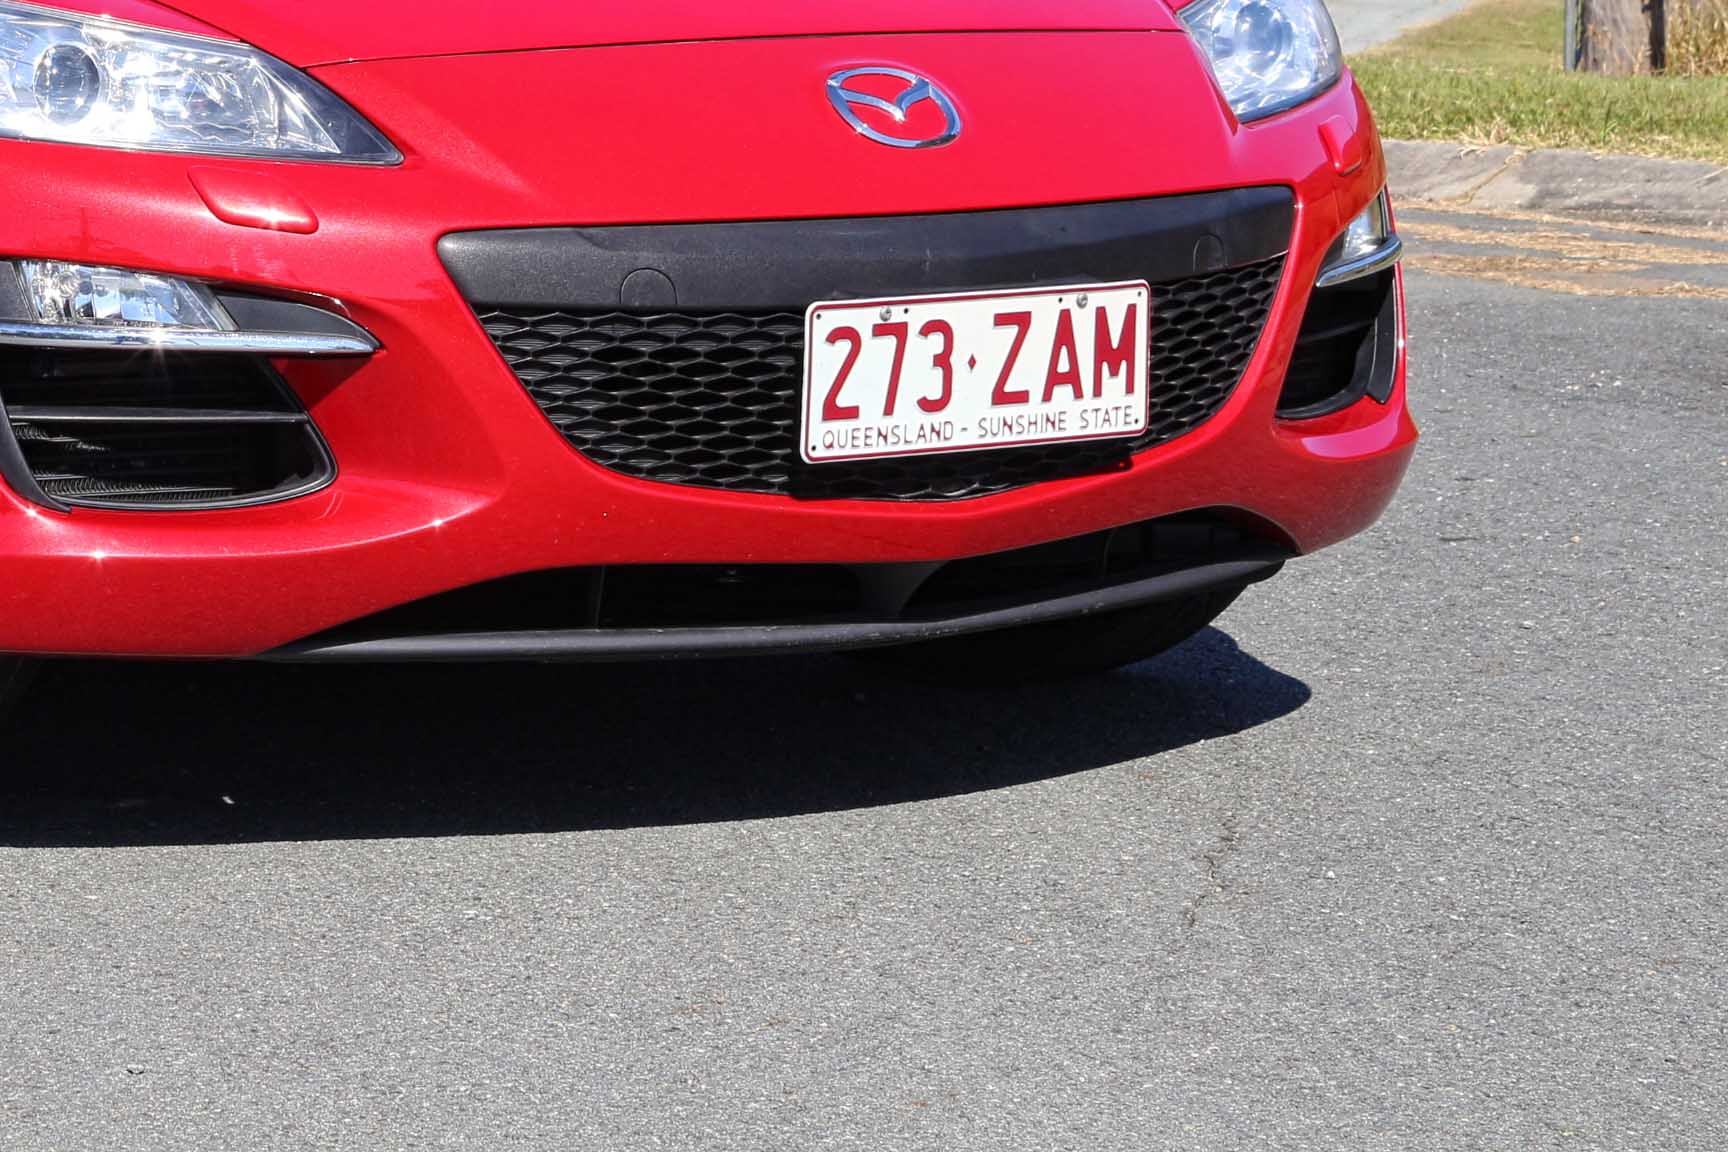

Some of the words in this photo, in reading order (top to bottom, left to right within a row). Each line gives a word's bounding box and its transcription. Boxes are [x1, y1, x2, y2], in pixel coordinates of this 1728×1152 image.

[822, 421, 954, 449] QUEENSLAND
[977, 411, 1068, 438] SUNSHINE
[1079, 405, 1134, 430] STATE
